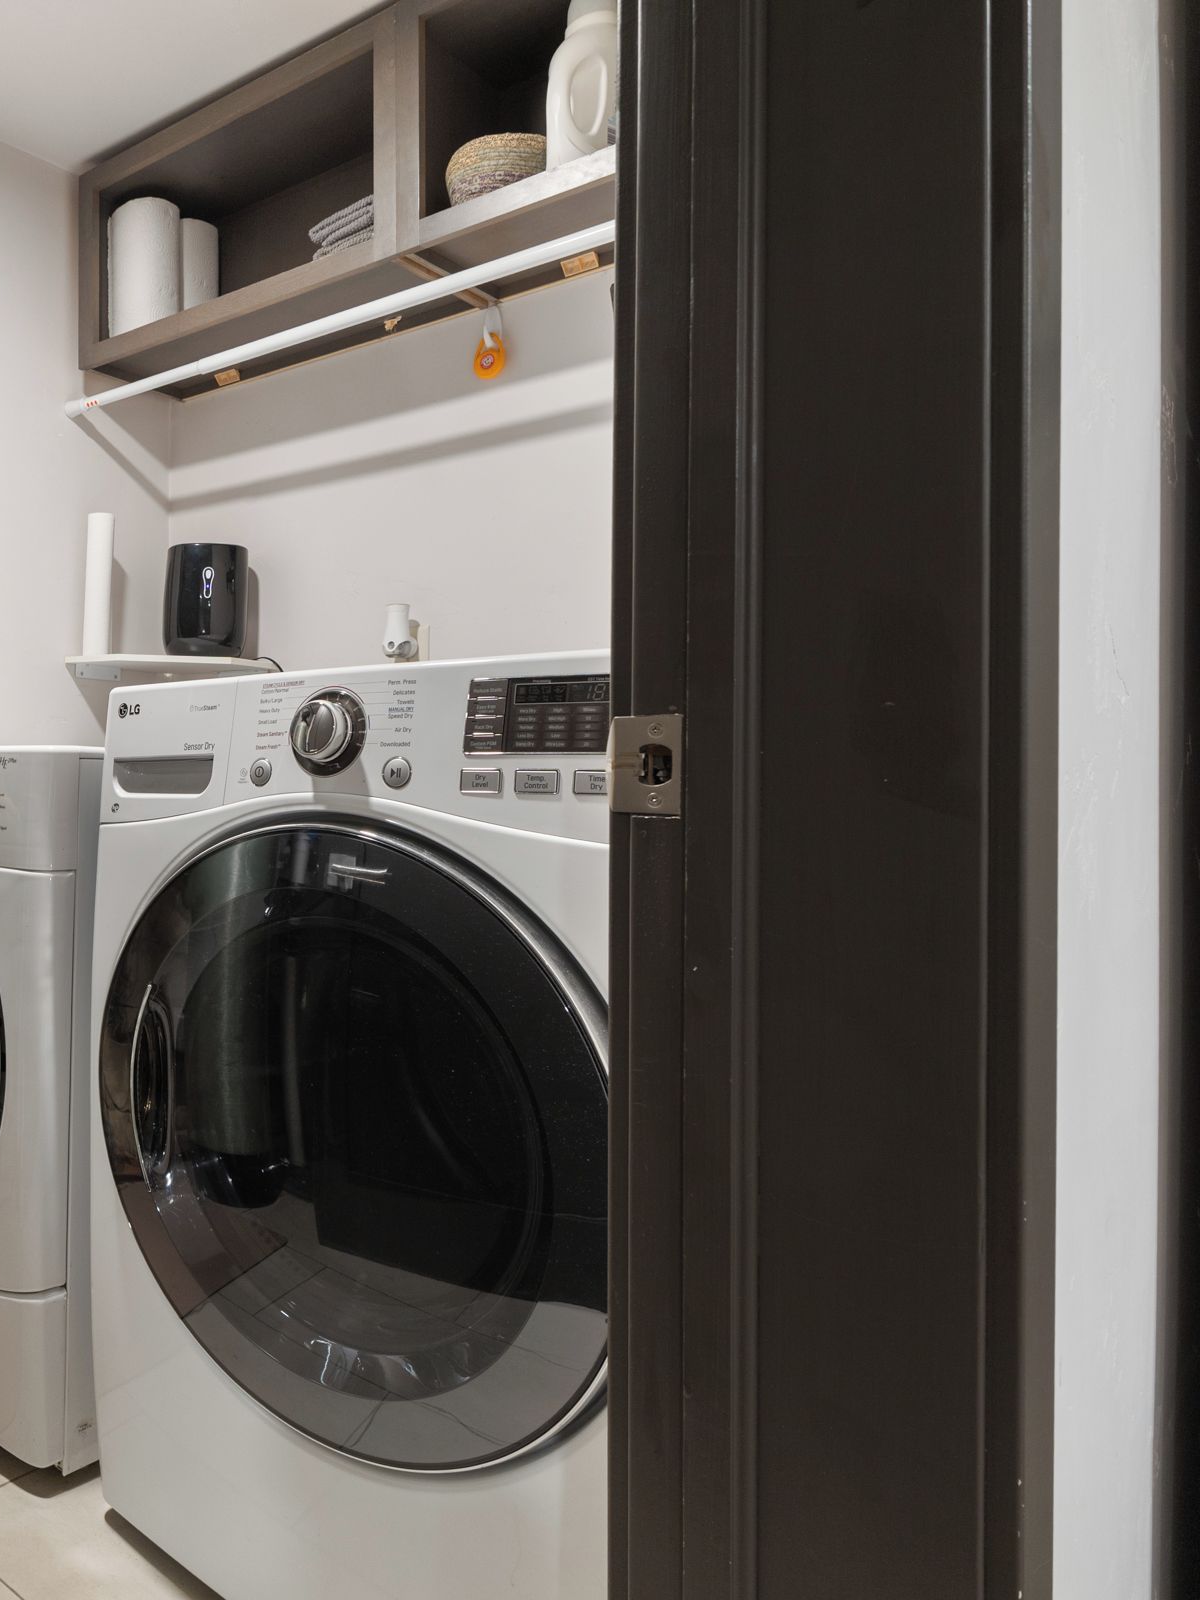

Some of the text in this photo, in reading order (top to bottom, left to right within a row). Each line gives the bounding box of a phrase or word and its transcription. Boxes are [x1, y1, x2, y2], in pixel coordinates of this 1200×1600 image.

[129, 703, 141, 716] LG
[183, 742, 216, 751] Sensor Dry
[474, 774, 487, 782] Dry
[526, 774, 546, 782] Temp.
